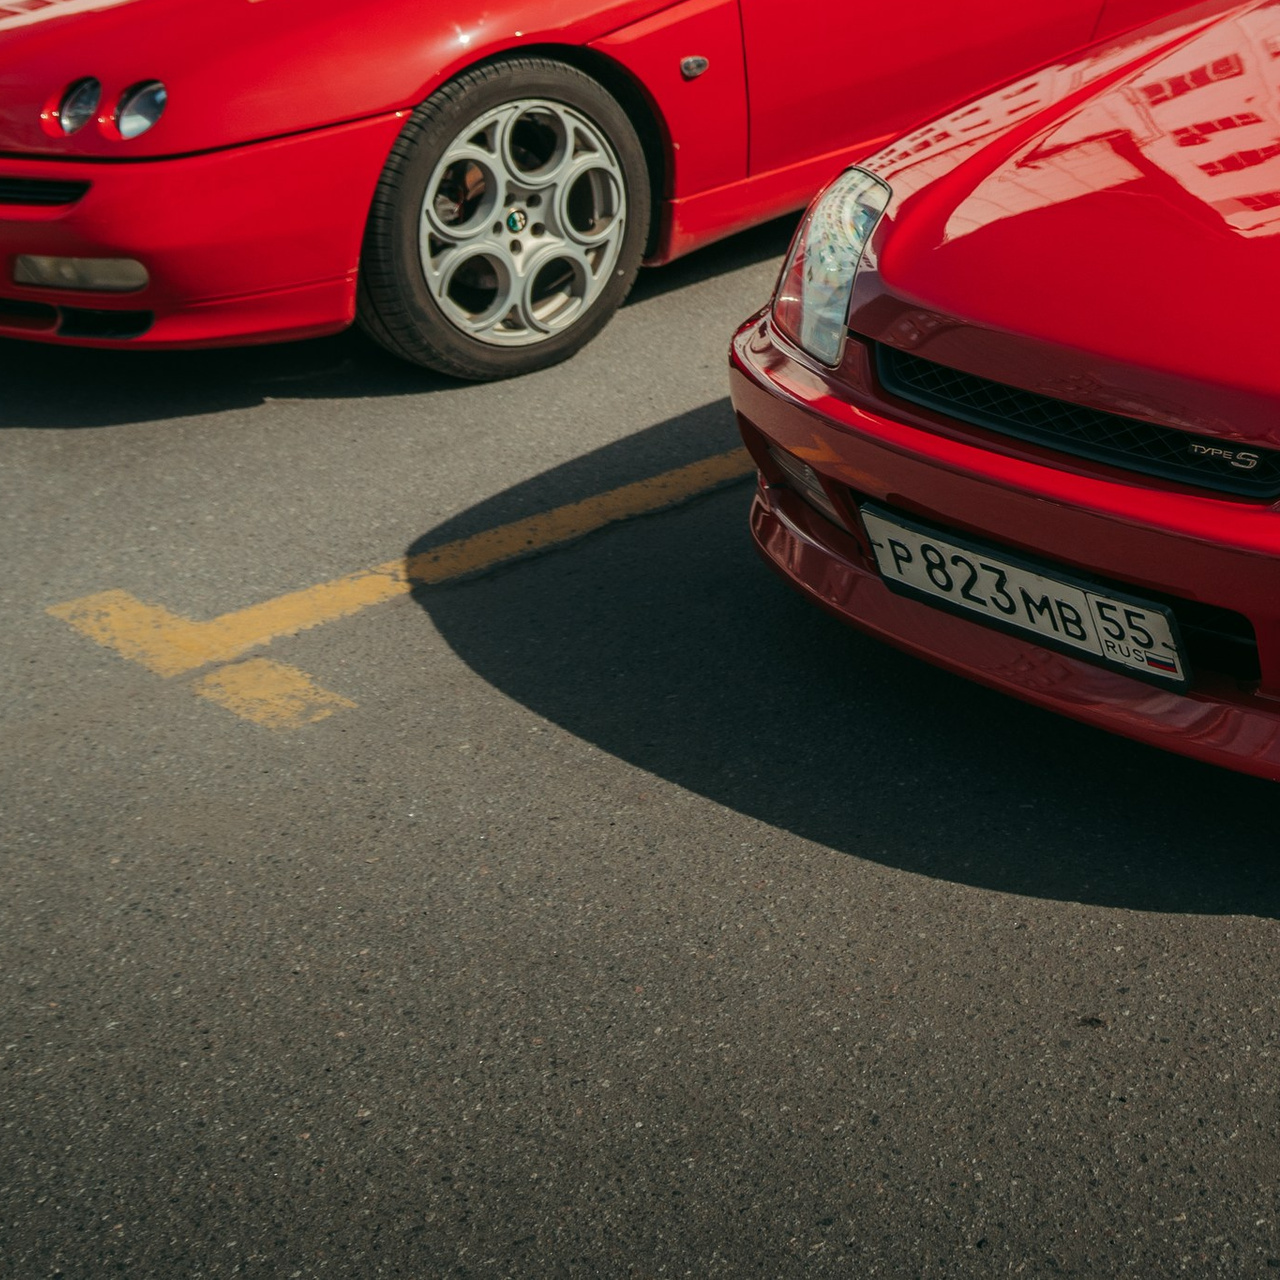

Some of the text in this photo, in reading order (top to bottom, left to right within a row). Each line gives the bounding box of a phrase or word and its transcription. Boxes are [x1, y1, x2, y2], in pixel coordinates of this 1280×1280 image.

[1191, 443, 1260, 470] TYPE S
[1095, 600, 1155, 650] 55
[1105, 639, 1145, 663] RUS
